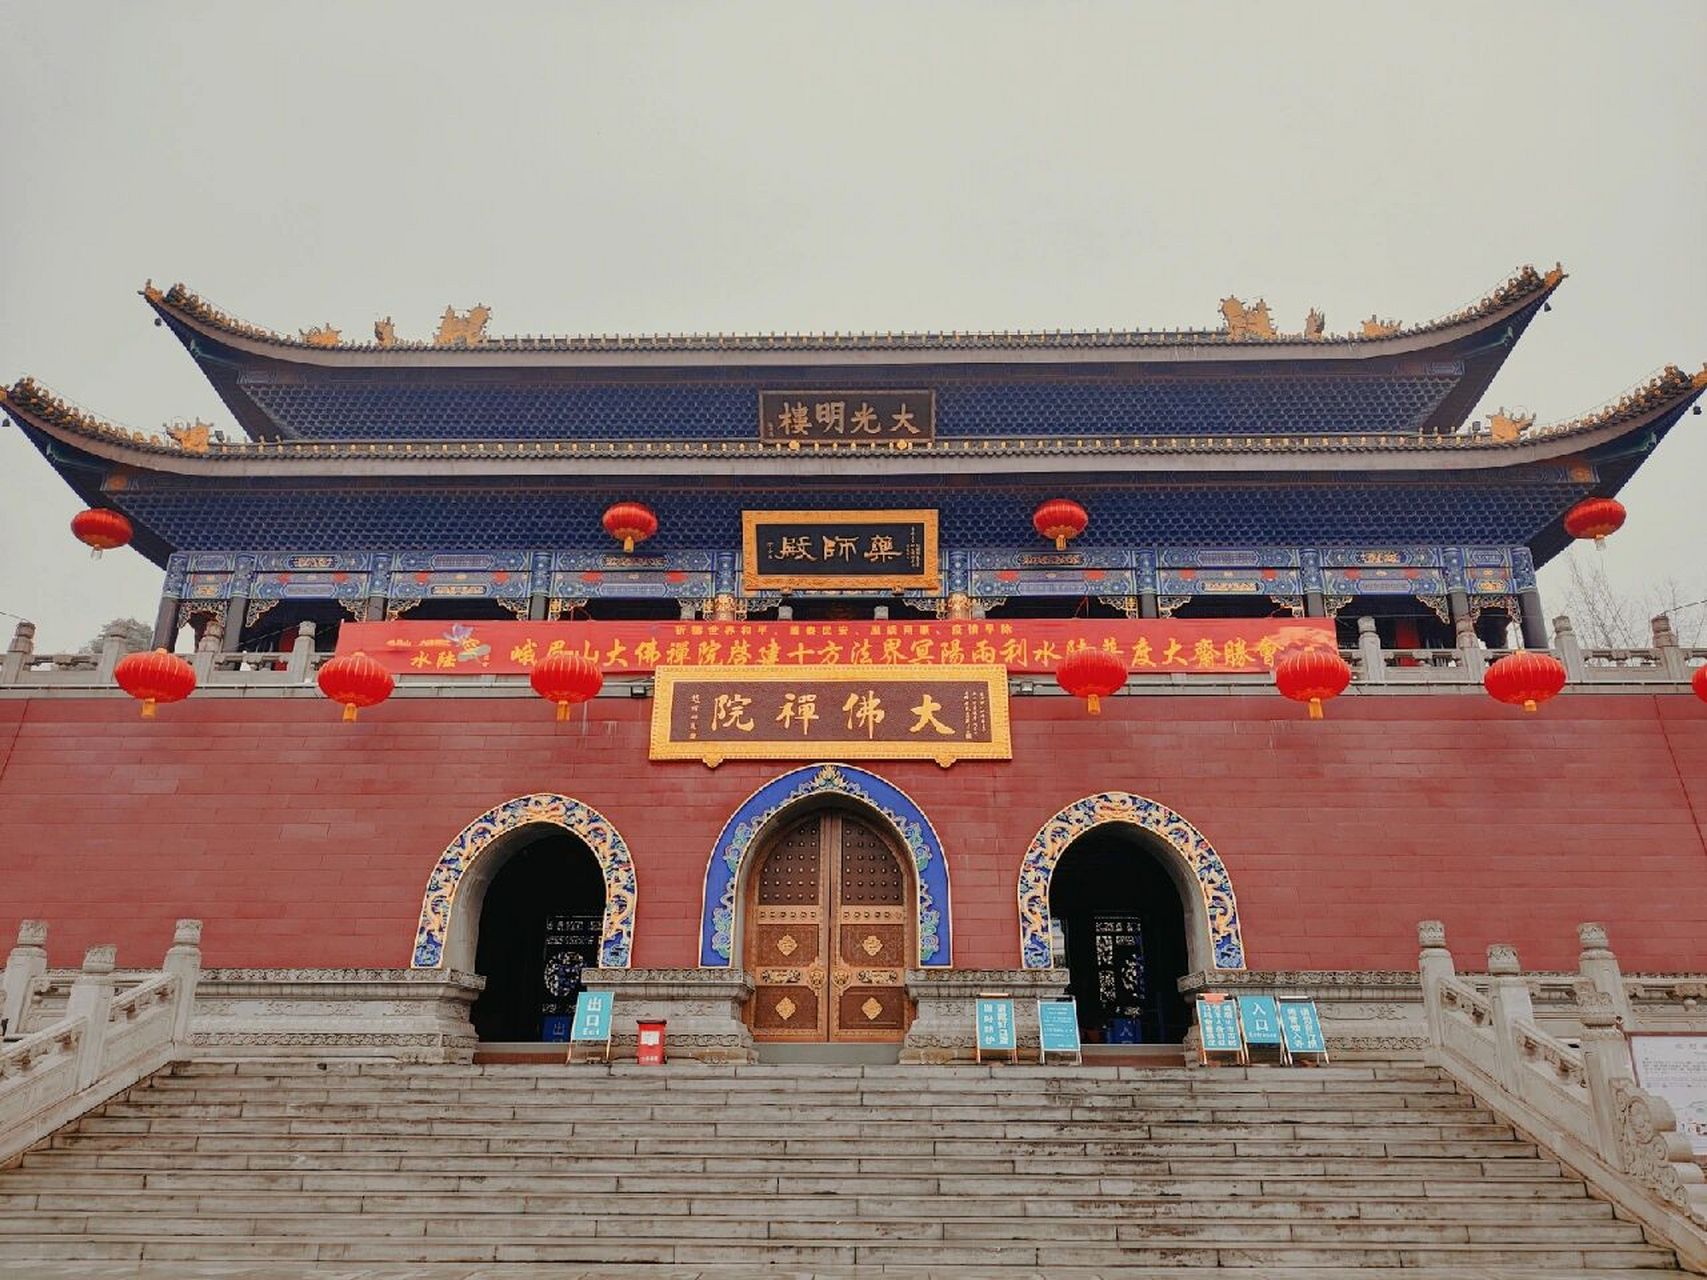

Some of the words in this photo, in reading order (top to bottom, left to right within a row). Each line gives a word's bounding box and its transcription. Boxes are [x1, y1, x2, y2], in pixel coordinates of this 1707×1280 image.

[778, 401, 920, 435] 大光明樓
[774, 534, 903, 563] 藥師殿
[711, 690, 955, 739] 大佛禪院
[586, 997, 602, 1026] 出口
[1252, 1002, 1268, 1031] 入口
